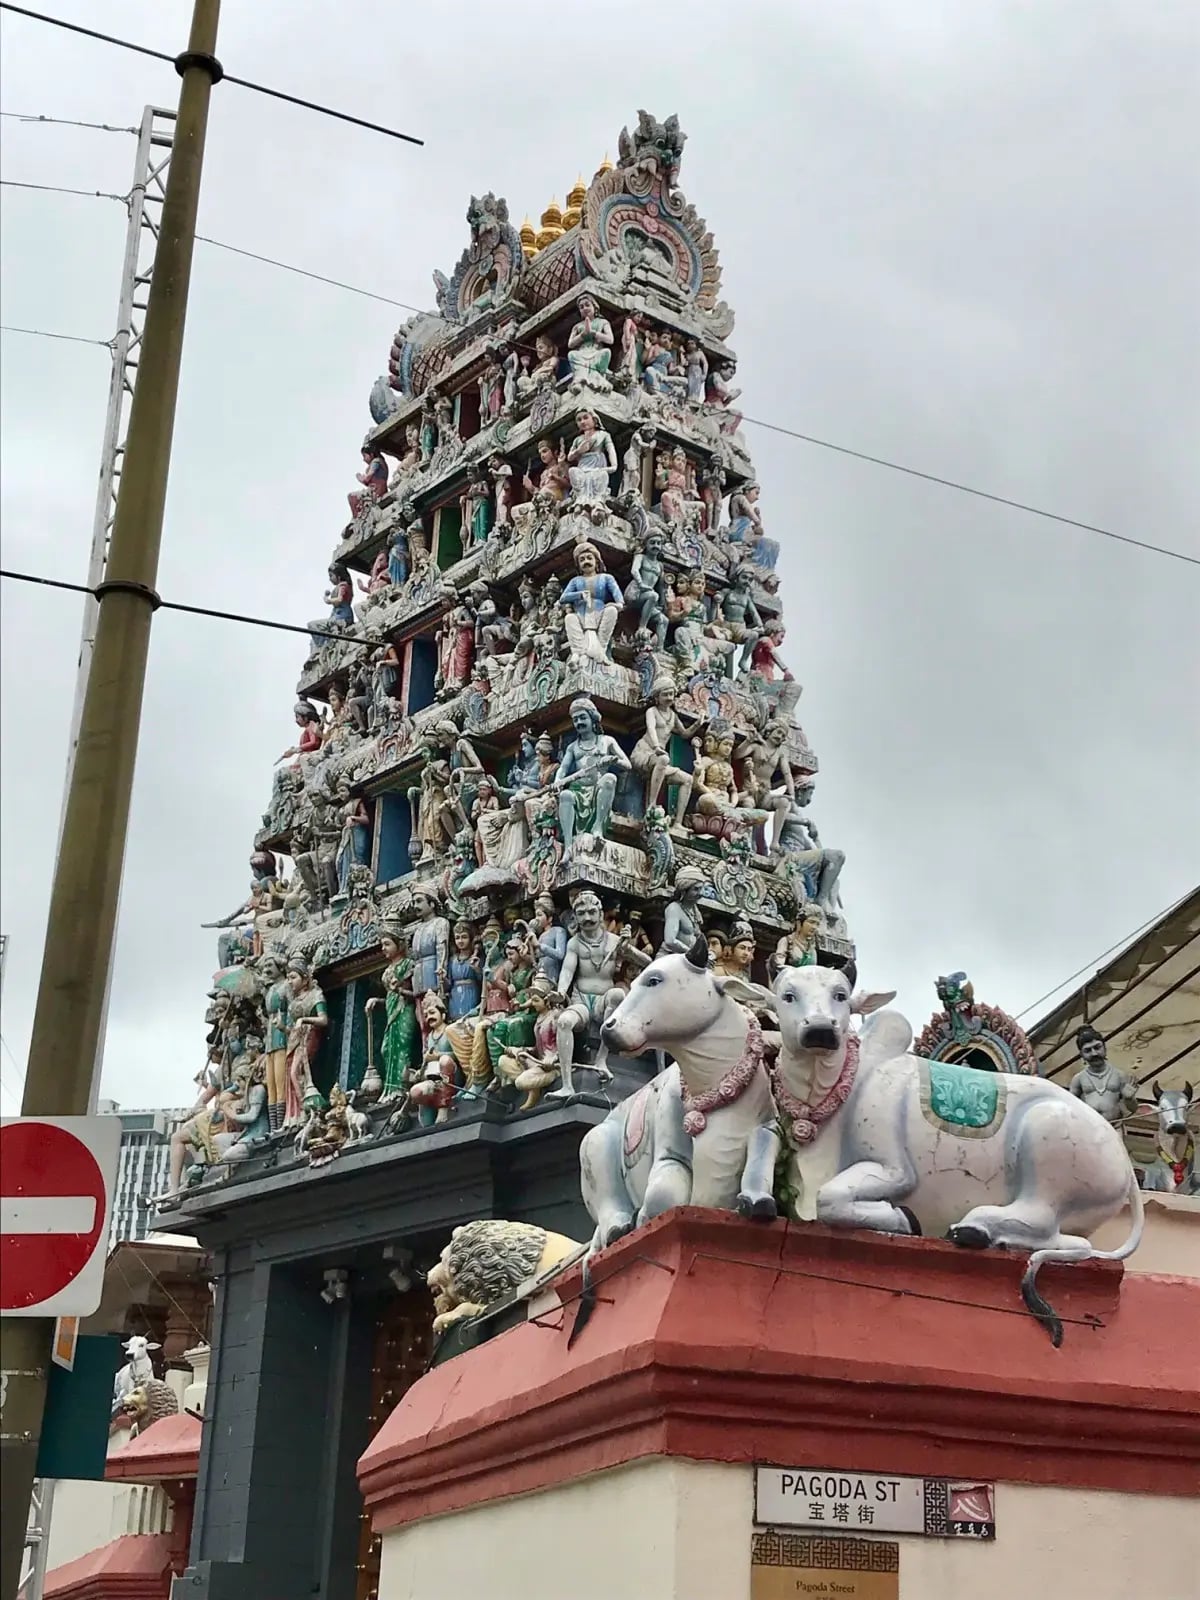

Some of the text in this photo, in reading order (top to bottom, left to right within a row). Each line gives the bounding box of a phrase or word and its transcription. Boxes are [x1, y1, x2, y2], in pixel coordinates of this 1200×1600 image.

[781, 1474, 901, 1502] PAGODA ST
[808, 1501, 875, 1525] 宝塔街
[795, 1580, 856, 1593] Pagoda Street
